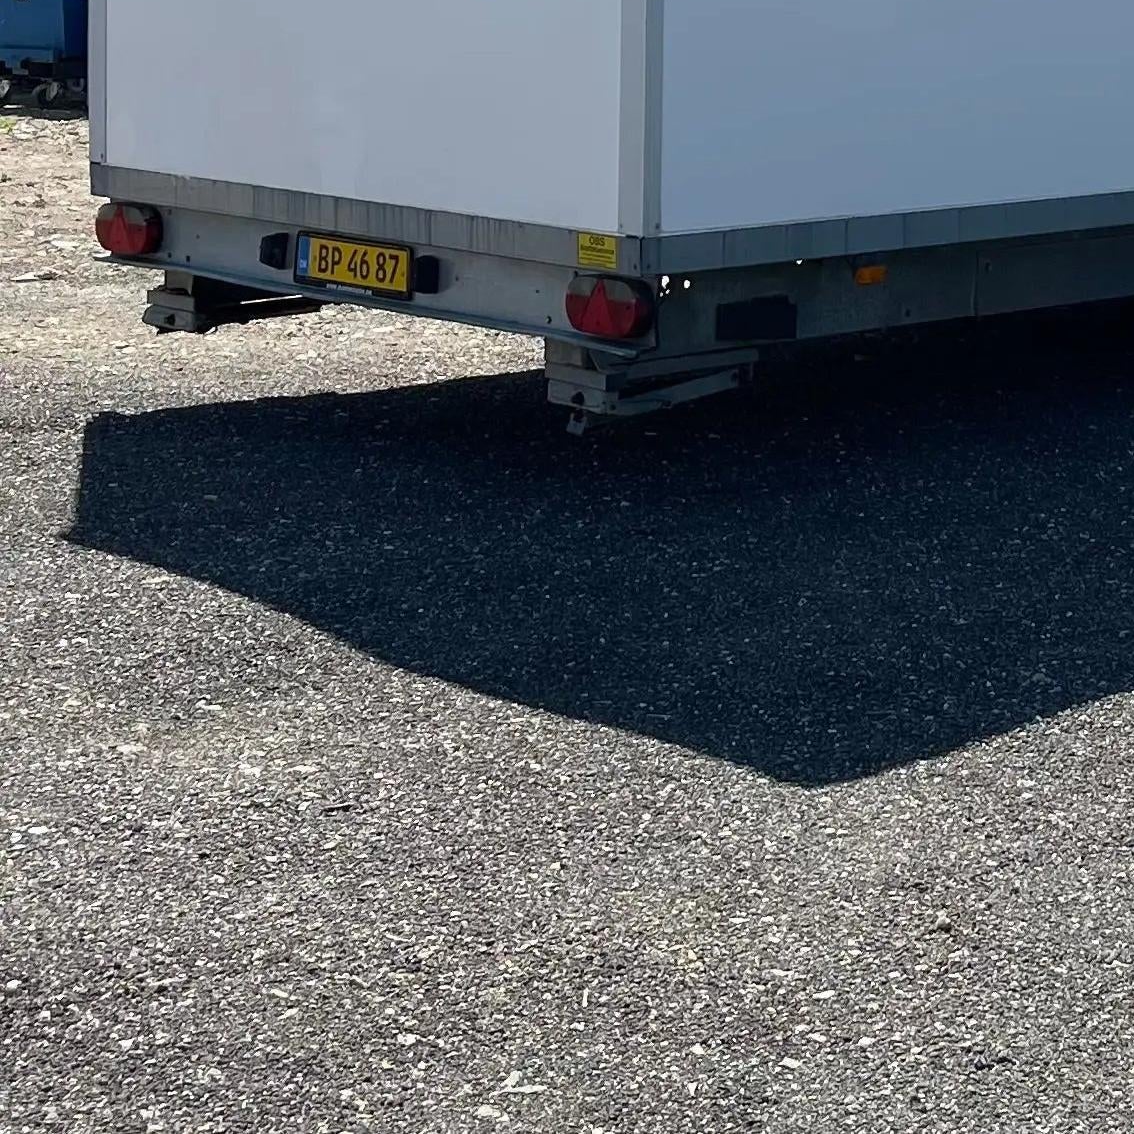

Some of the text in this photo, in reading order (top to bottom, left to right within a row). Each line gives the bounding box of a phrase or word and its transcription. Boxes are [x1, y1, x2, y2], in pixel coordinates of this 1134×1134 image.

[317, 244, 400, 283] BP 46 87
